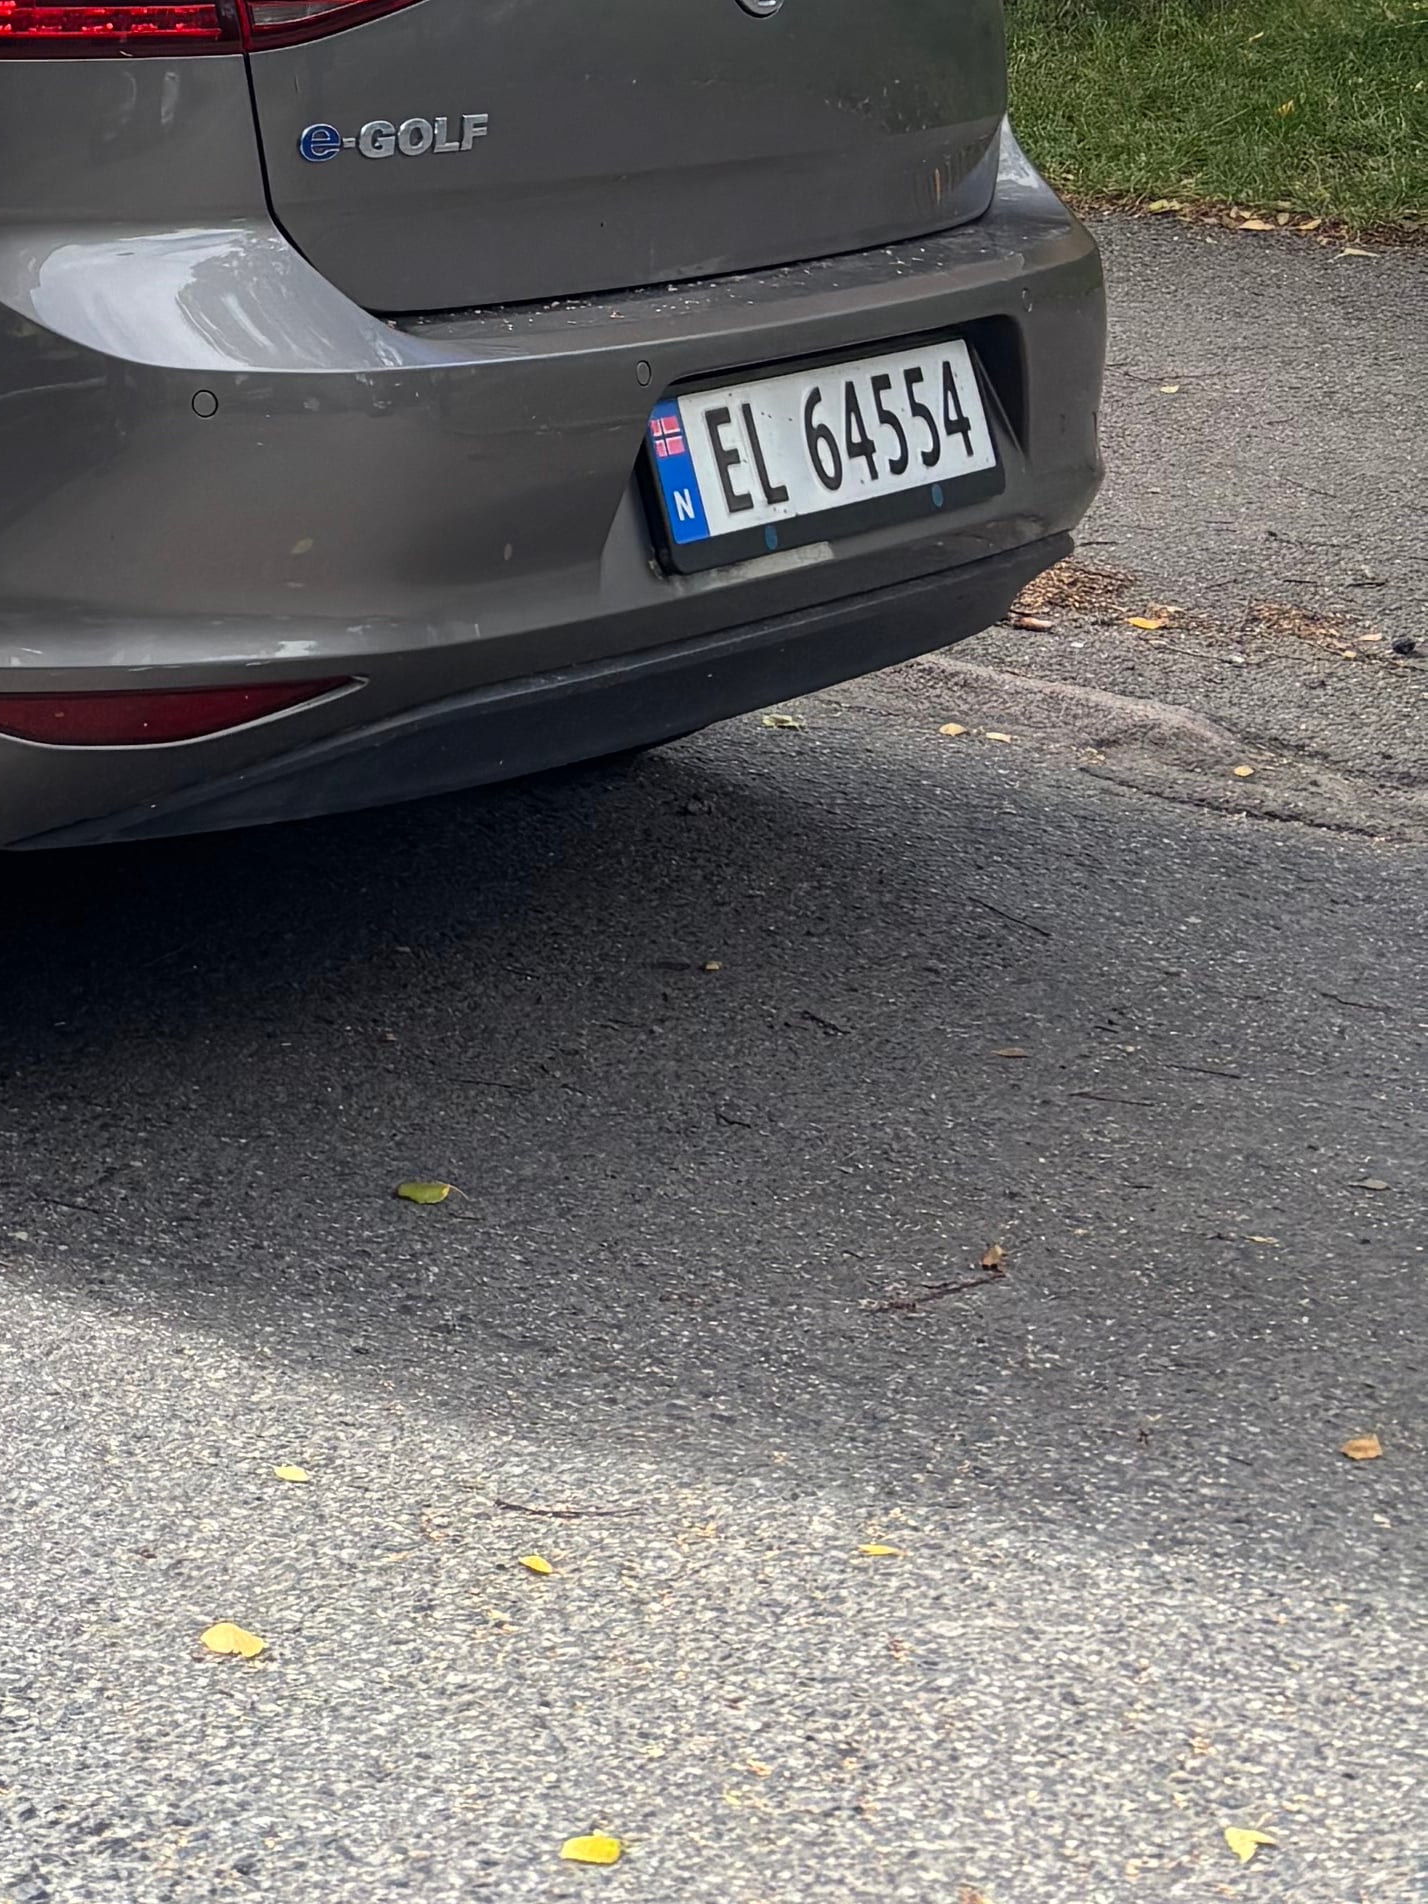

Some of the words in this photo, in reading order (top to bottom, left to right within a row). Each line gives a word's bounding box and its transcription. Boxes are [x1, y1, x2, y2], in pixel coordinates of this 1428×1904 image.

[299, 113, 489, 162] e-GOLF
[704, 403, 789, 514] EL
[803, 360, 974, 491] 64554
[673, 488, 696, 521] N
